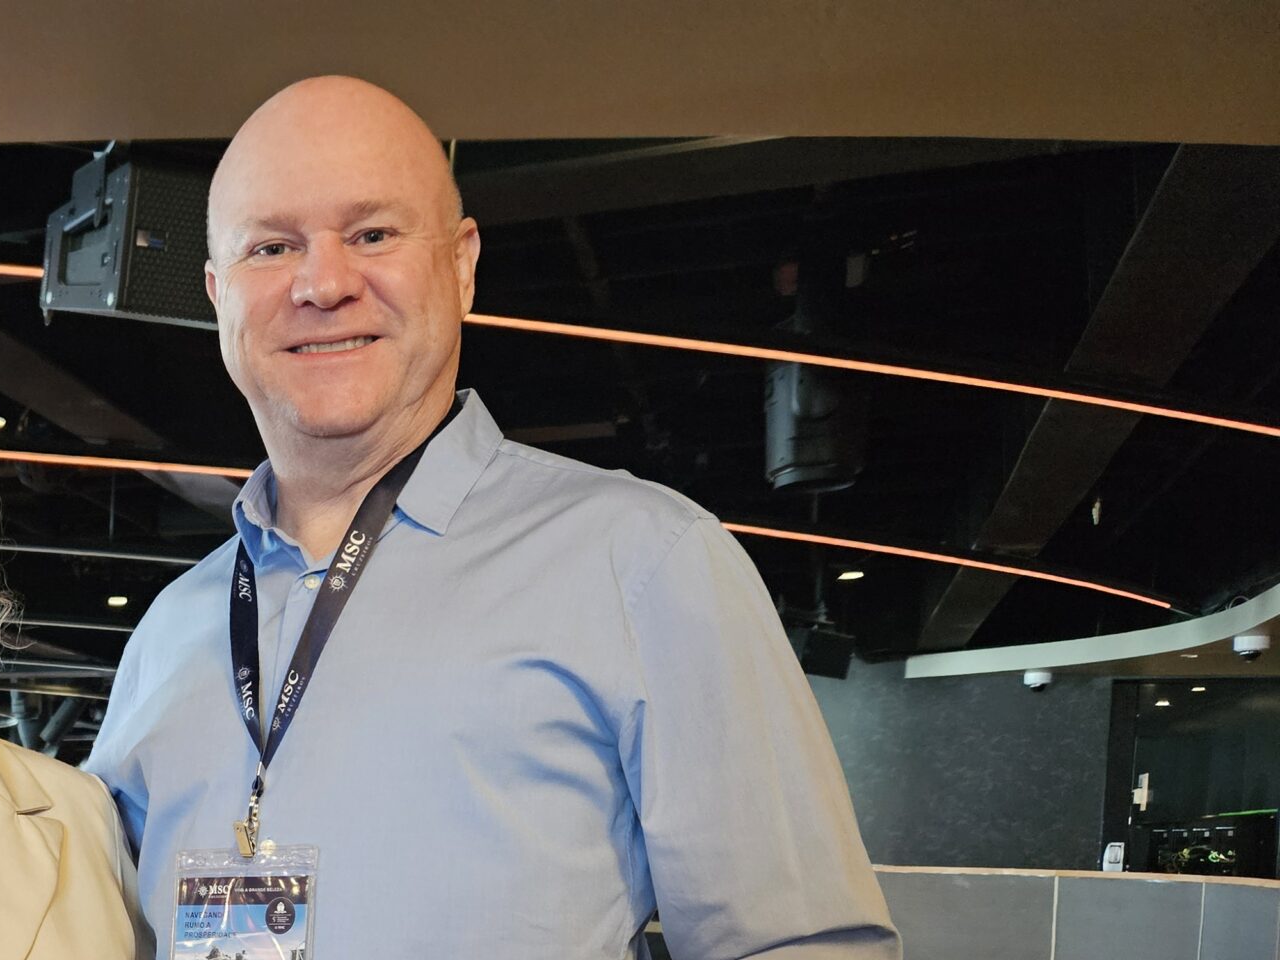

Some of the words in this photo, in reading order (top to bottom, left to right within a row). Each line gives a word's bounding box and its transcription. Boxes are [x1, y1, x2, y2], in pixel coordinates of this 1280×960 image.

[336, 530, 366, 573] MSC
[238, 572, 252, 602] MSC
[240, 681, 255, 720] MSC
[277, 669, 299, 714] MSC
[209, 884, 229, 895] MSC
[185, 911, 224, 919] NAVEGAND
